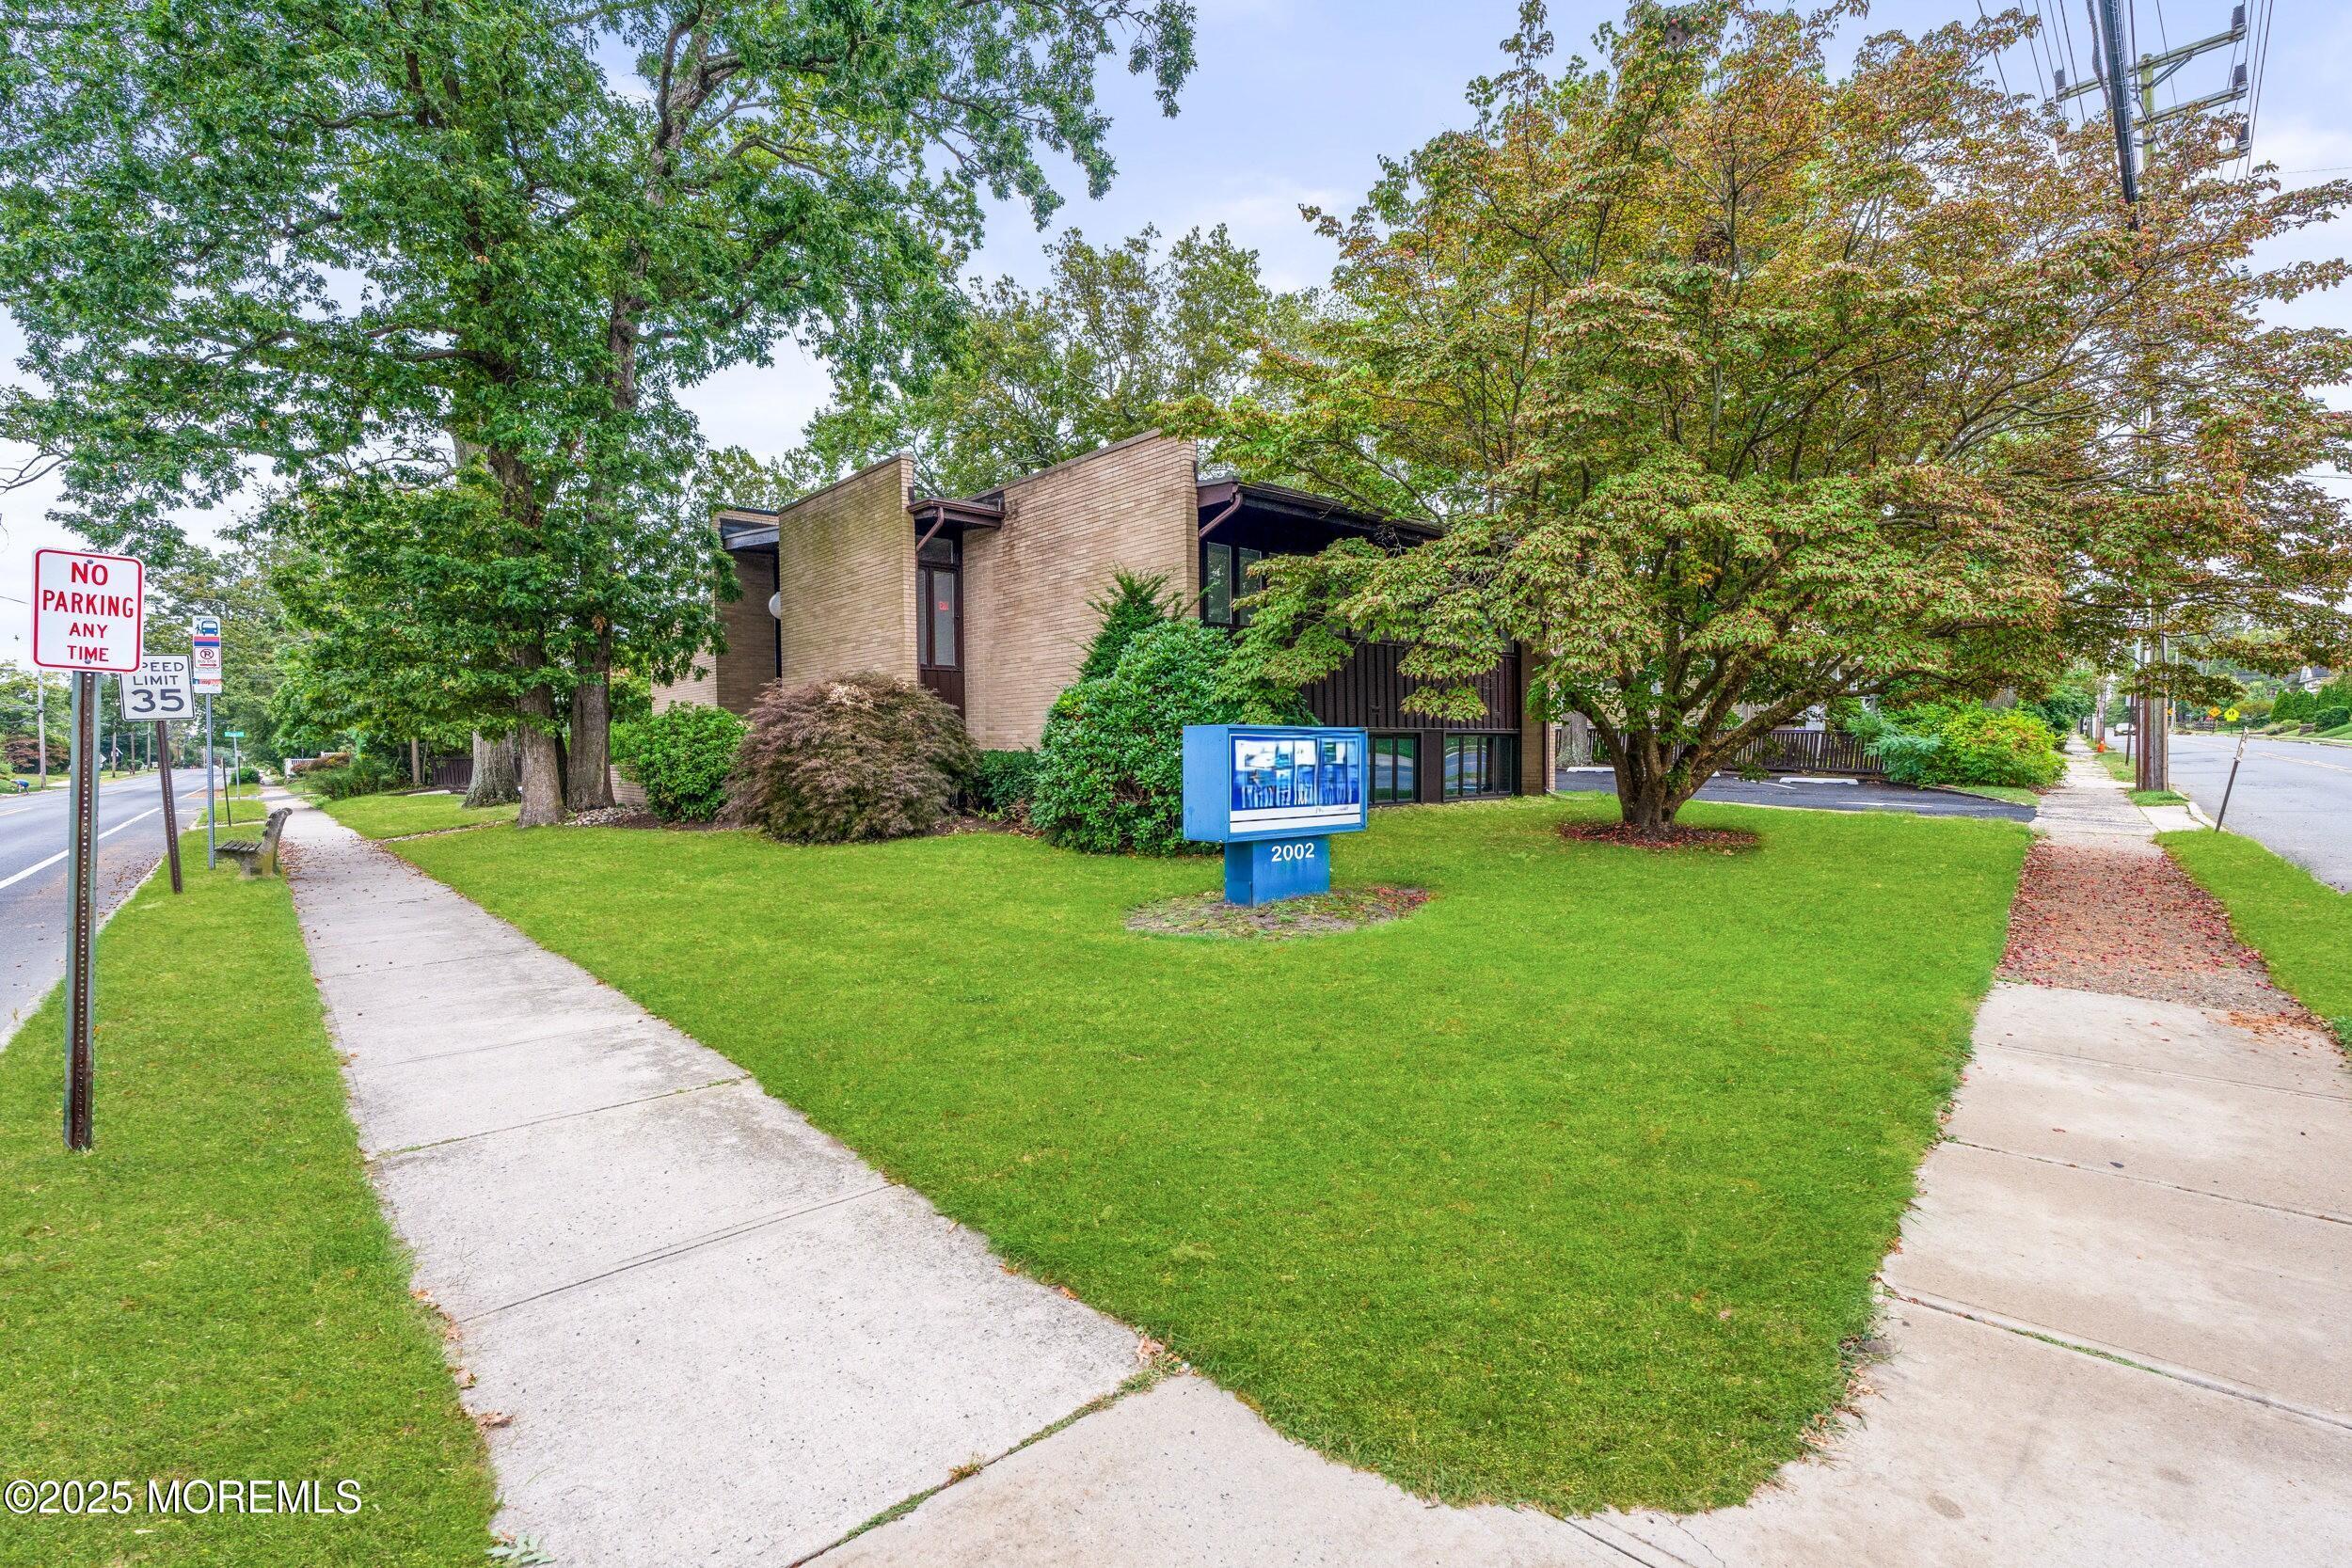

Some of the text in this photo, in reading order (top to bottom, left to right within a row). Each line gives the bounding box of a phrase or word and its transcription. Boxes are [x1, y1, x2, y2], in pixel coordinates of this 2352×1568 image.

[71, 562, 108, 586] NO
[42, 589, 134, 618] PARKING
[69, 622, 108, 639] ANY
[67, 645, 109, 662] TIME
[133, 674, 179, 686] LIMIT
[131, 689, 185, 713] 35
[1271, 842, 1315, 863] 2002
